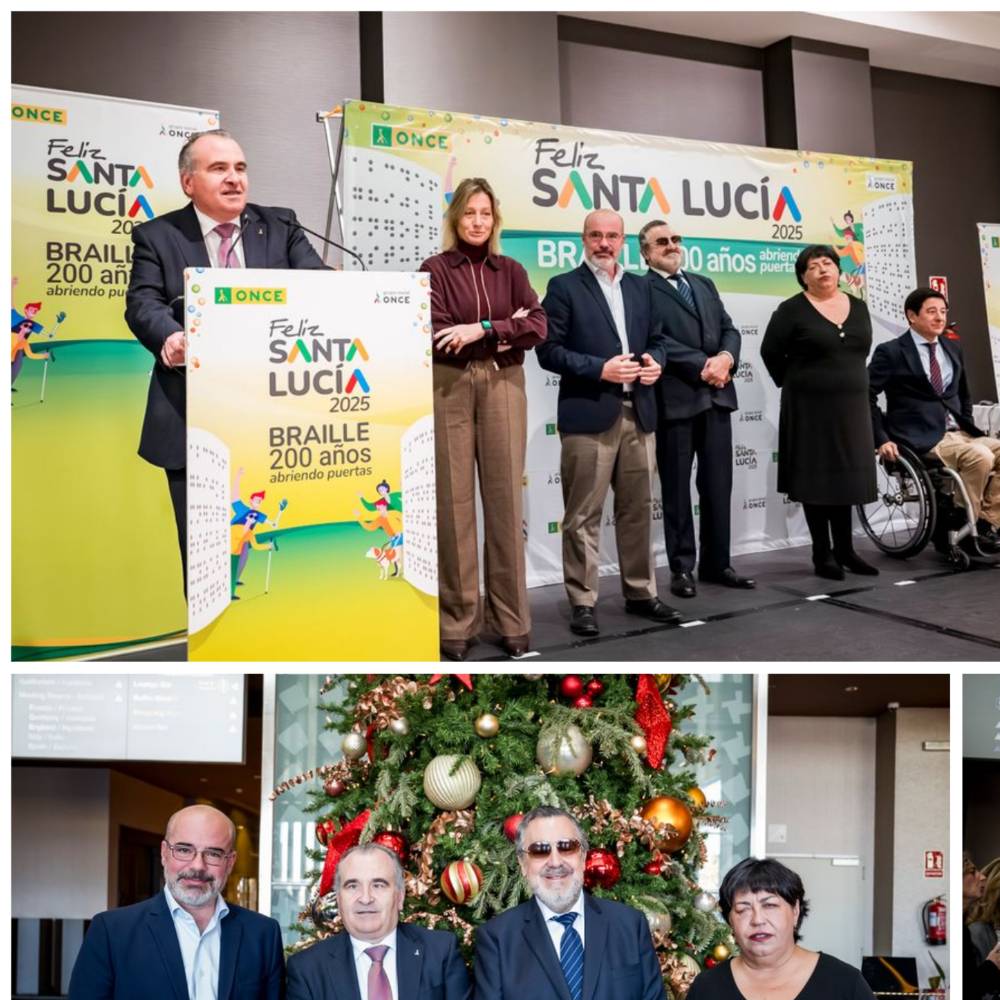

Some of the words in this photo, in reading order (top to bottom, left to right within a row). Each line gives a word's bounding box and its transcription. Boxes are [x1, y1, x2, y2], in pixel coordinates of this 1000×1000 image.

[12, 106, 63, 122] ONCE
[169, 129, 195, 138] ONC
[396, 131, 449, 150] ONCE
[47, 138, 107, 160] Feliz
[534, 138, 605, 169] Feliz
[47, 158, 154, 189] SANTA
[532, 168, 671, 215] SANTA
[682, 176, 802, 223] LUCÍA
[874, 182, 895, 190] ONCE
[47, 188, 155, 219] LUCÍA
[771, 224, 803, 240] 2025
[46, 242, 134, 264] BRAILL
[707, 246, 757, 273] años
[760, 248, 800, 261] abriend
[46, 263, 93, 284] 200
[100, 264, 133, 285] añ
[760, 262, 796, 275] puerta
[46, 285, 105, 297] abriendo
[236, 290, 283, 302] ONCE
[383, 296, 411, 304] ONCE
[269, 319, 325, 337] Feliz
[269, 338, 369, 363] SANTA
[269, 363, 370, 397] LUCÍA
[329, 396, 370, 412] 2025
[269, 422, 370, 447] BRAILLE
[270, 446, 312, 470] 200
[319, 443, 372, 466] años
[270, 470, 324, 483] abriendo
[327, 465, 372, 481] puertas
